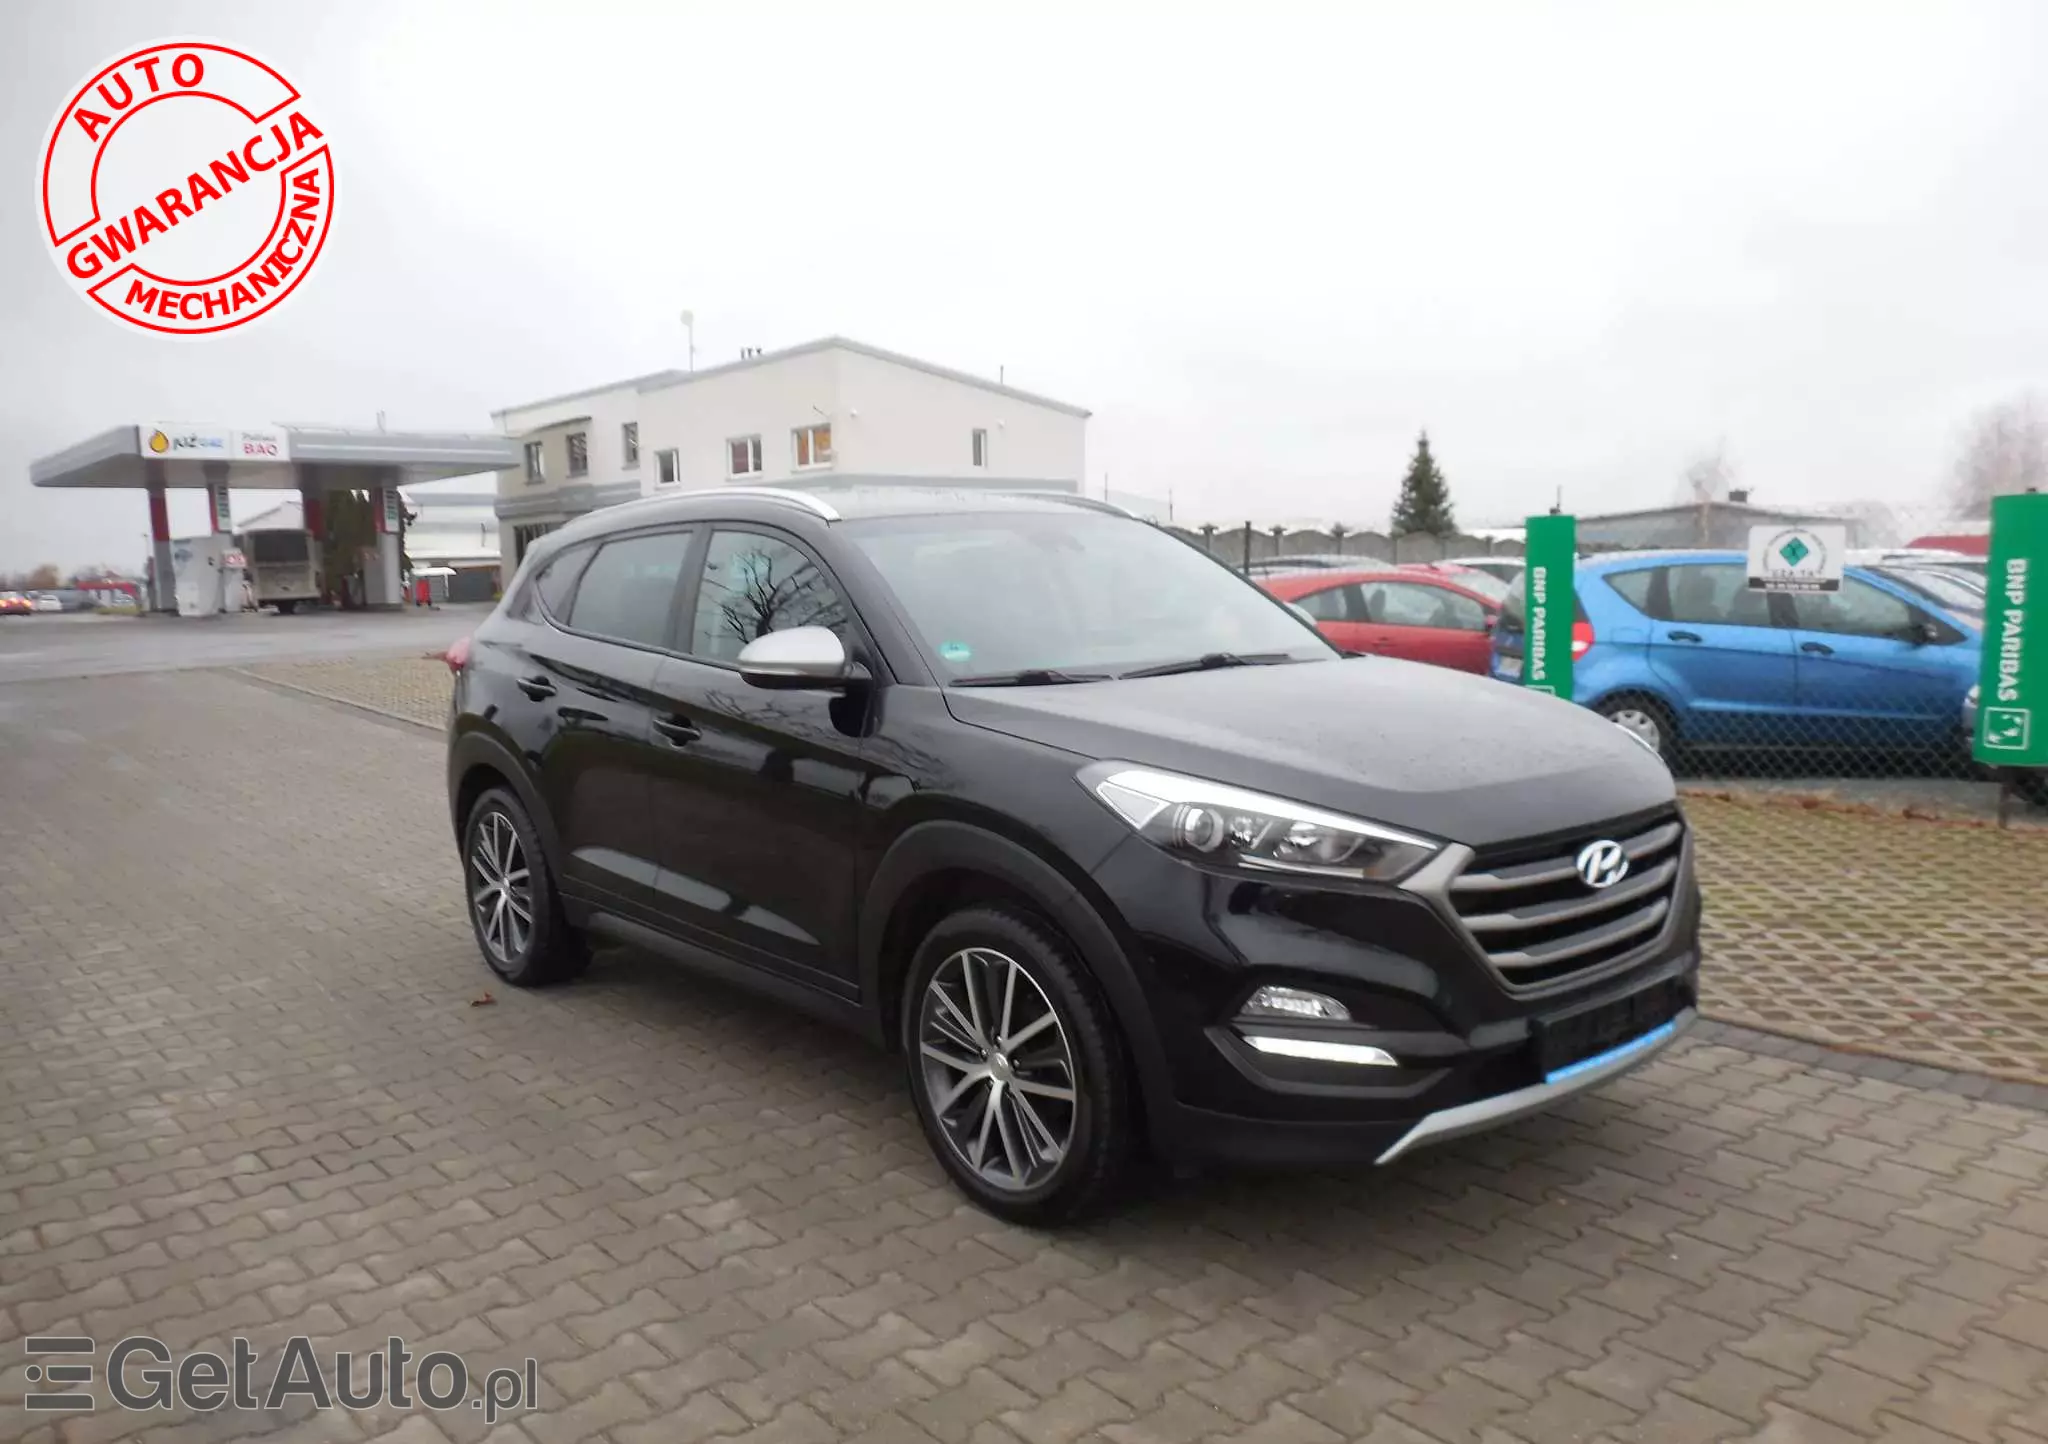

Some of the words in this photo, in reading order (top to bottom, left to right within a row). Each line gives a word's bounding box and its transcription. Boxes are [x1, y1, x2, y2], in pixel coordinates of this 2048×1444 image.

[1532, 566, 1547, 604] BNP
[2004, 558, 2028, 605] BNP
[1531, 606, 1546, 681] PARIBAS
[1997, 608, 2025, 701] PARIBAS
